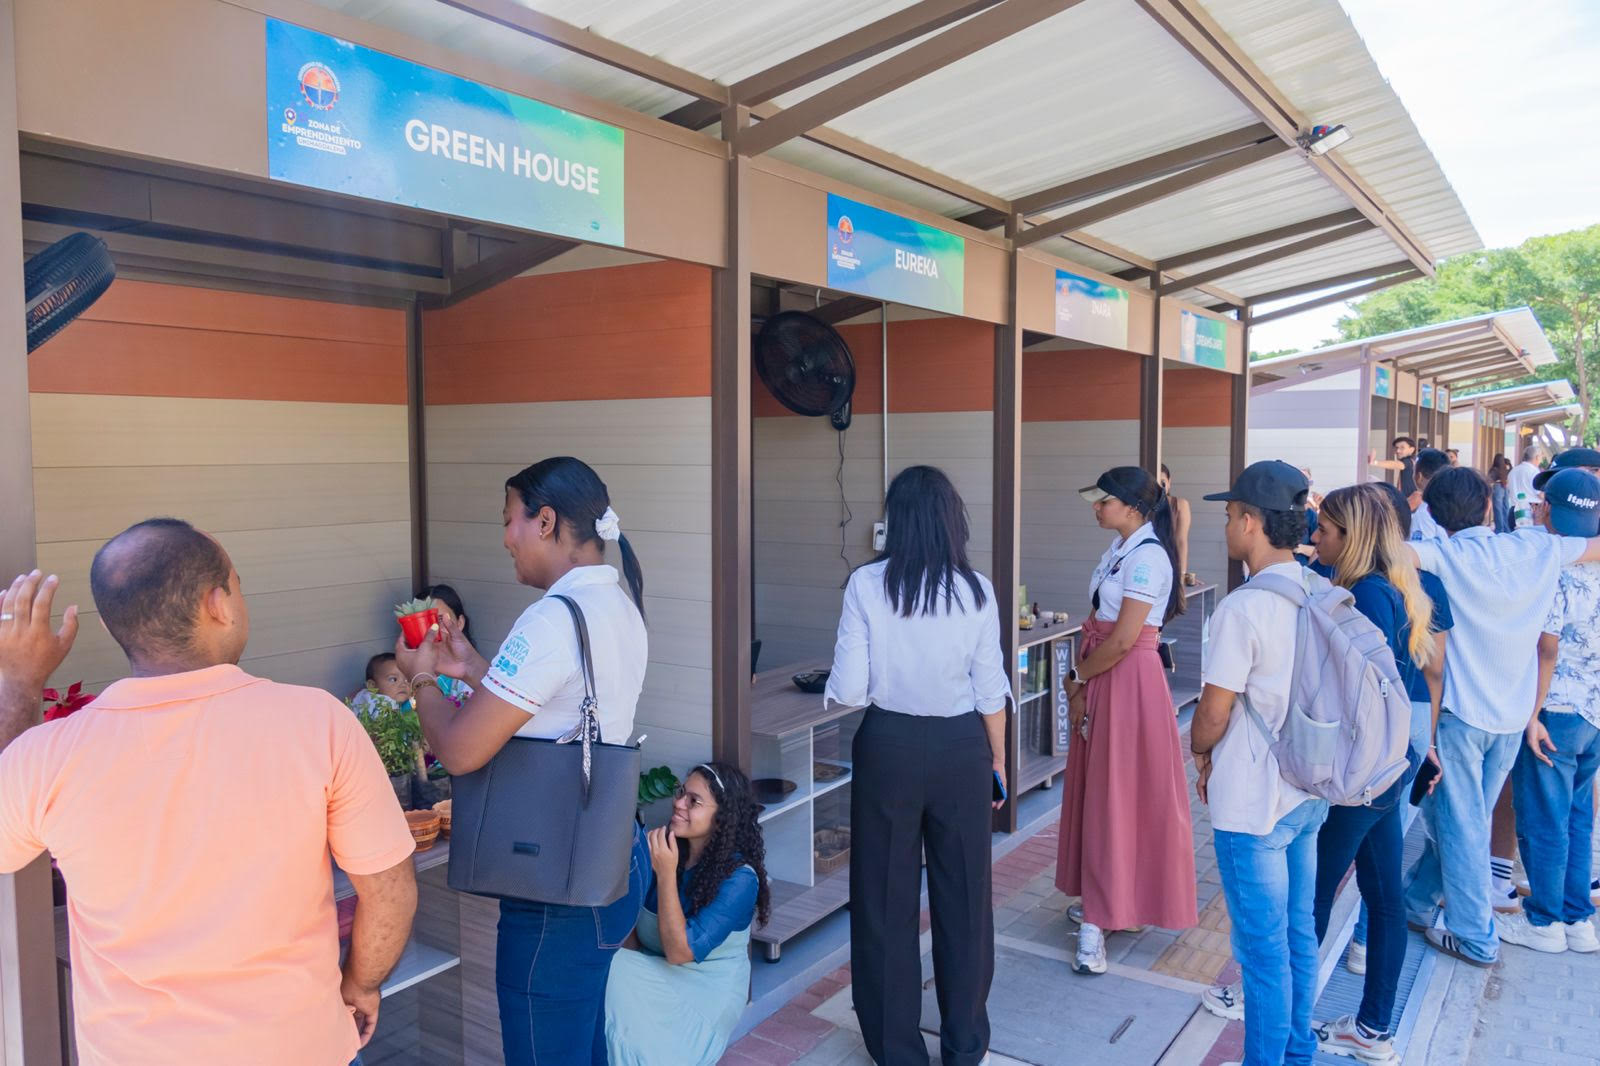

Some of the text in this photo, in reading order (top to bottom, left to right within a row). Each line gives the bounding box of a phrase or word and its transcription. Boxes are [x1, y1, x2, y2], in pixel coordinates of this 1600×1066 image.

[282, 123, 361, 149] EMPRENDIMIENTO
[308, 119, 341, 134] ZONA DE
[404, 118, 600, 195] GREEN HOUSE
[895, 248, 939, 279] EUREKA
[1055, 648, 1069, 744] WELCOME
